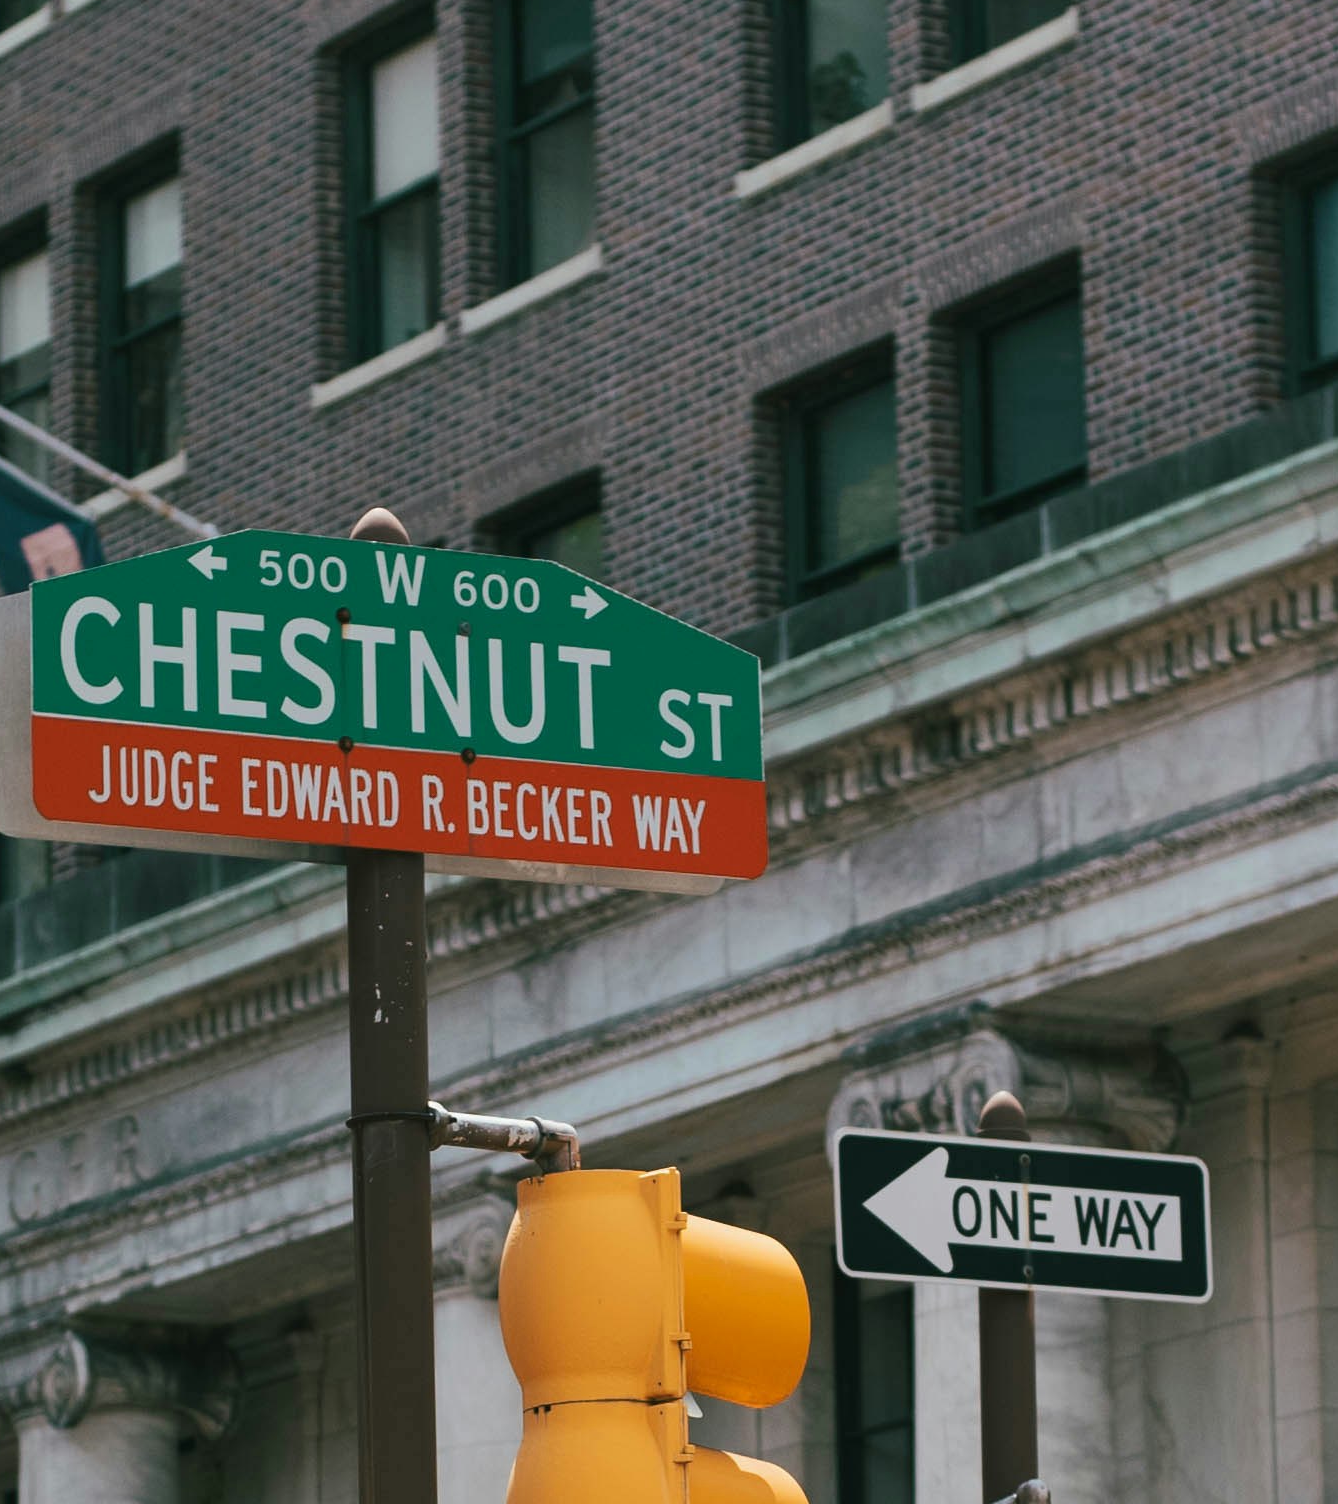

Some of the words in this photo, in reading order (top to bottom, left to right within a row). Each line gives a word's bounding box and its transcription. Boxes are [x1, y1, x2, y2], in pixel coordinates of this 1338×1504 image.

[259, 550, 348, 593] 500
[374, 550, 426, 607] W
[453, 570, 541, 614] 600
[59, 595, 612, 750] CHESTNUT
[658, 690, 734, 762] ST
[89, 744, 220, 813] JUDGE
[241, 757, 400, 828] EDWARD
[422, 775, 456, 834] R.
[467, 779, 613, 847] BECKER
[632, 794, 706, 855] WAY
[952, 1185, 1055, 1244] ONE
[1074, 1194, 1167, 1252] WAY
